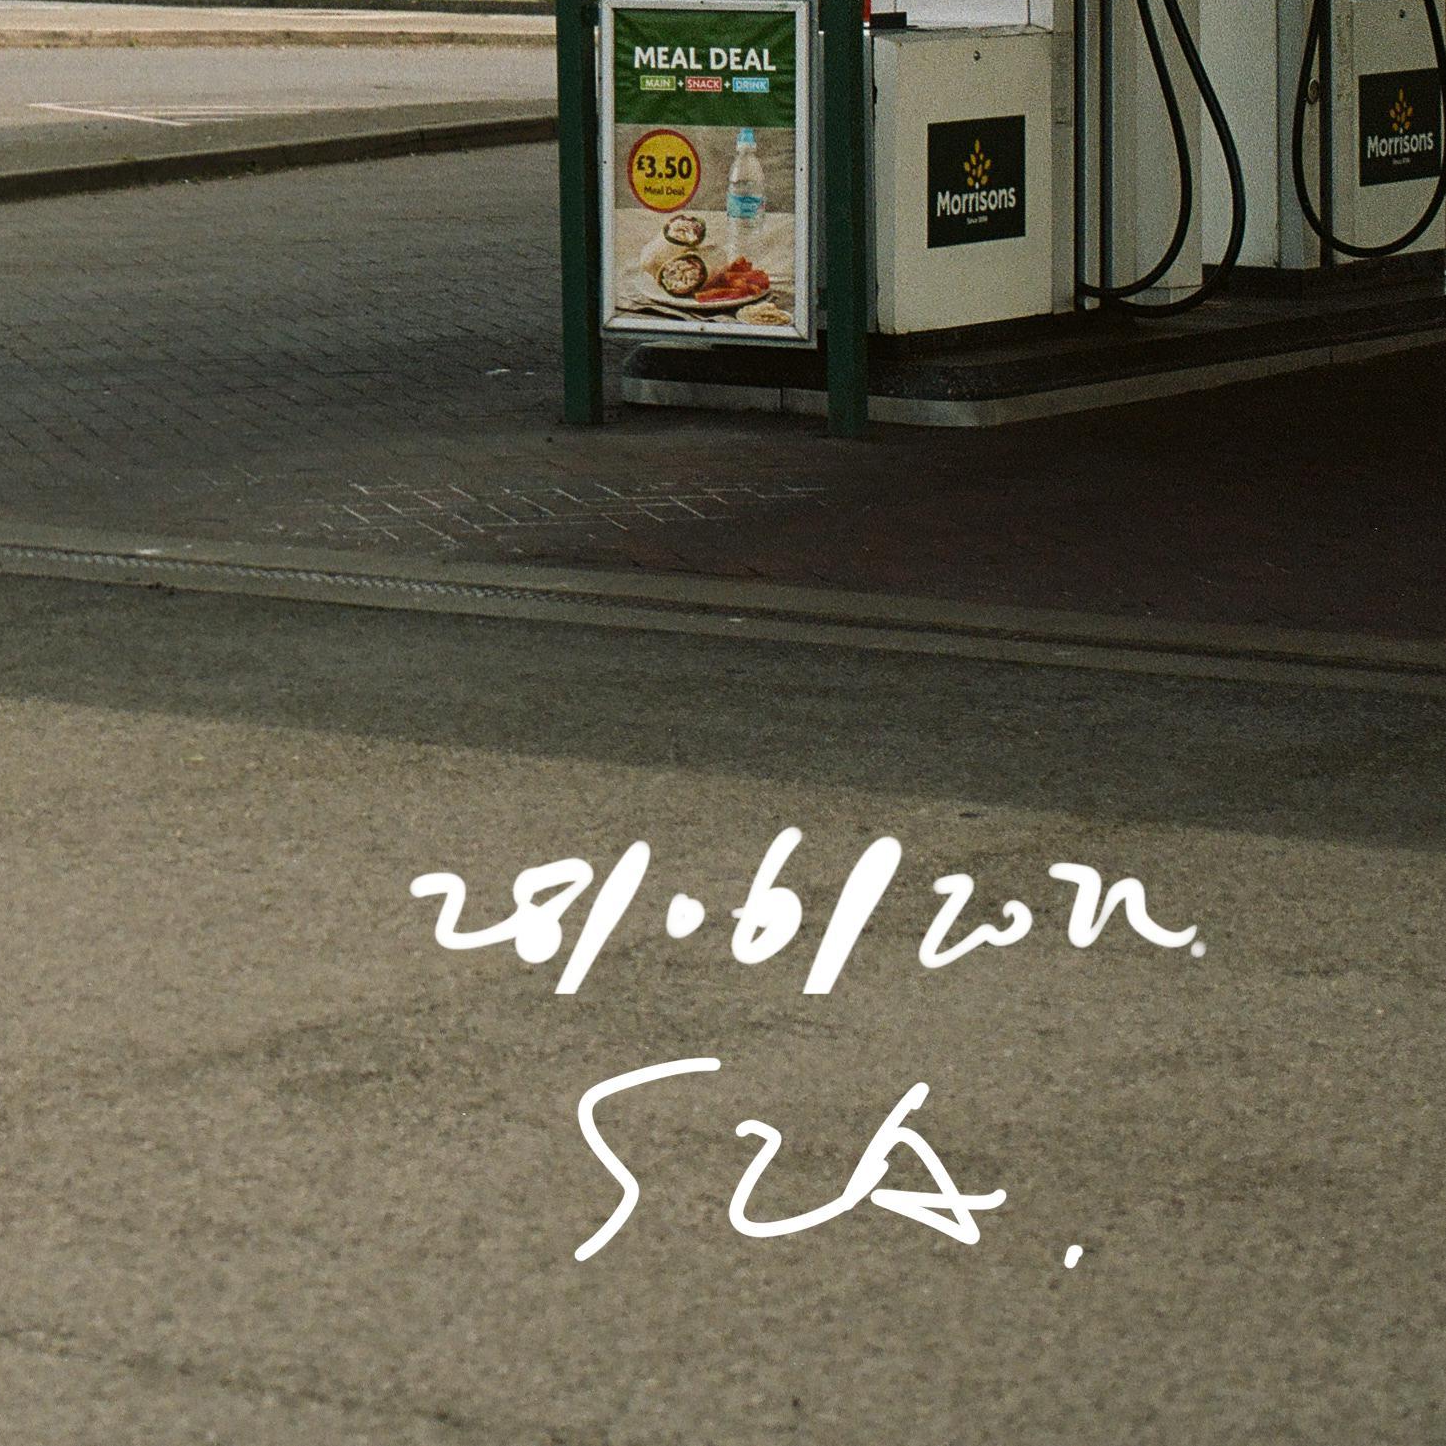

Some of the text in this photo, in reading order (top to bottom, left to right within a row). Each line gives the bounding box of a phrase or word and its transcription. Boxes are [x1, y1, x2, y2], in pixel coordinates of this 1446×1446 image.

[633, 46, 777, 72] MEAL DEAL
[645, 78, 671, 88] MAIN
[686, 78, 721, 90] SNACK
[735, 80, 768, 91] DRINK
[1366, 127, 1435, 159] Morrisons
[636, 155, 693, 180] £3.50
[643, 186, 686, 197] Meal Deal
[936, 181, 1017, 218] Morrisons
